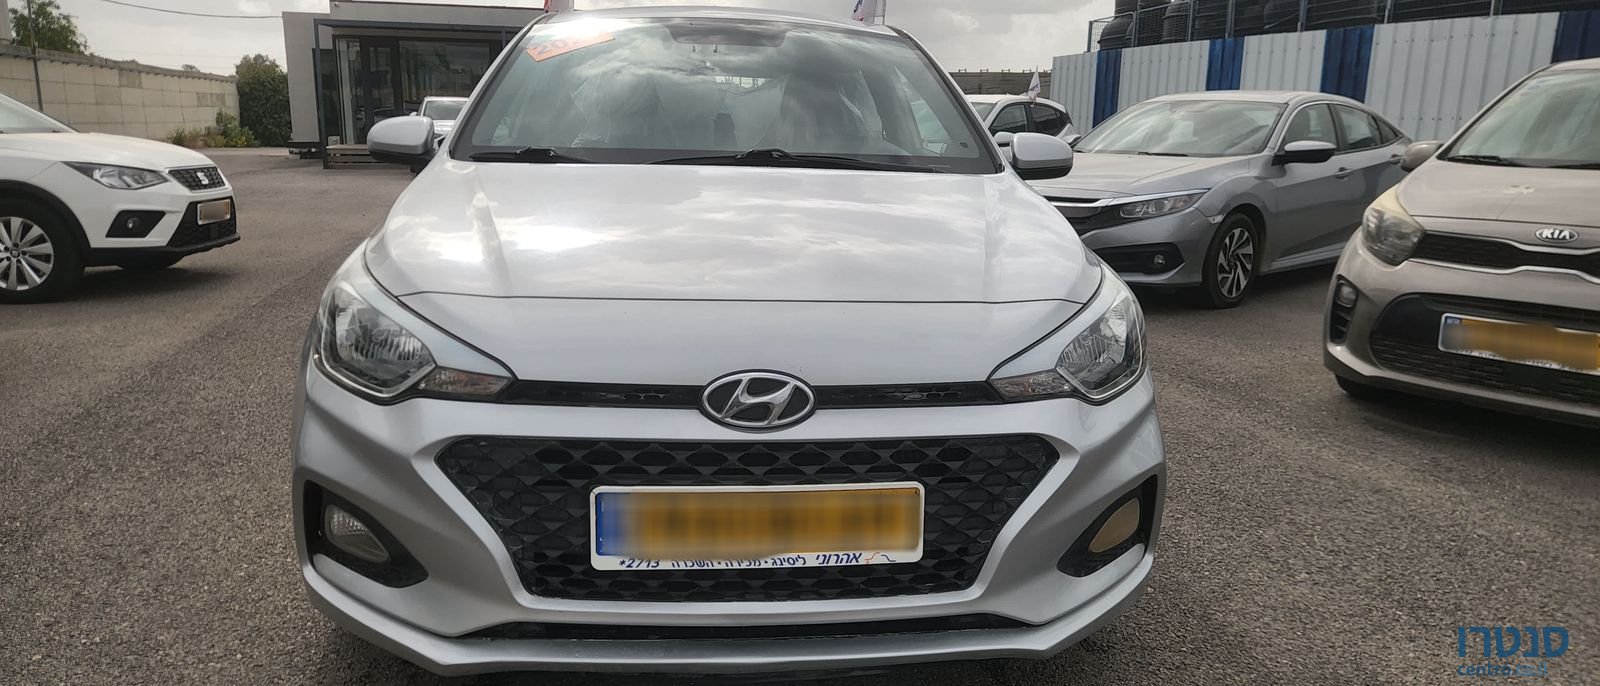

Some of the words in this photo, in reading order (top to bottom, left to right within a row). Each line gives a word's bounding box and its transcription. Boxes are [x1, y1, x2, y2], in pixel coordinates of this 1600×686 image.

[1542, 228, 1570, 240] KIA
[772, 554, 806, 567] ליסינג
[816, 552, 862, 565] אהרוני
